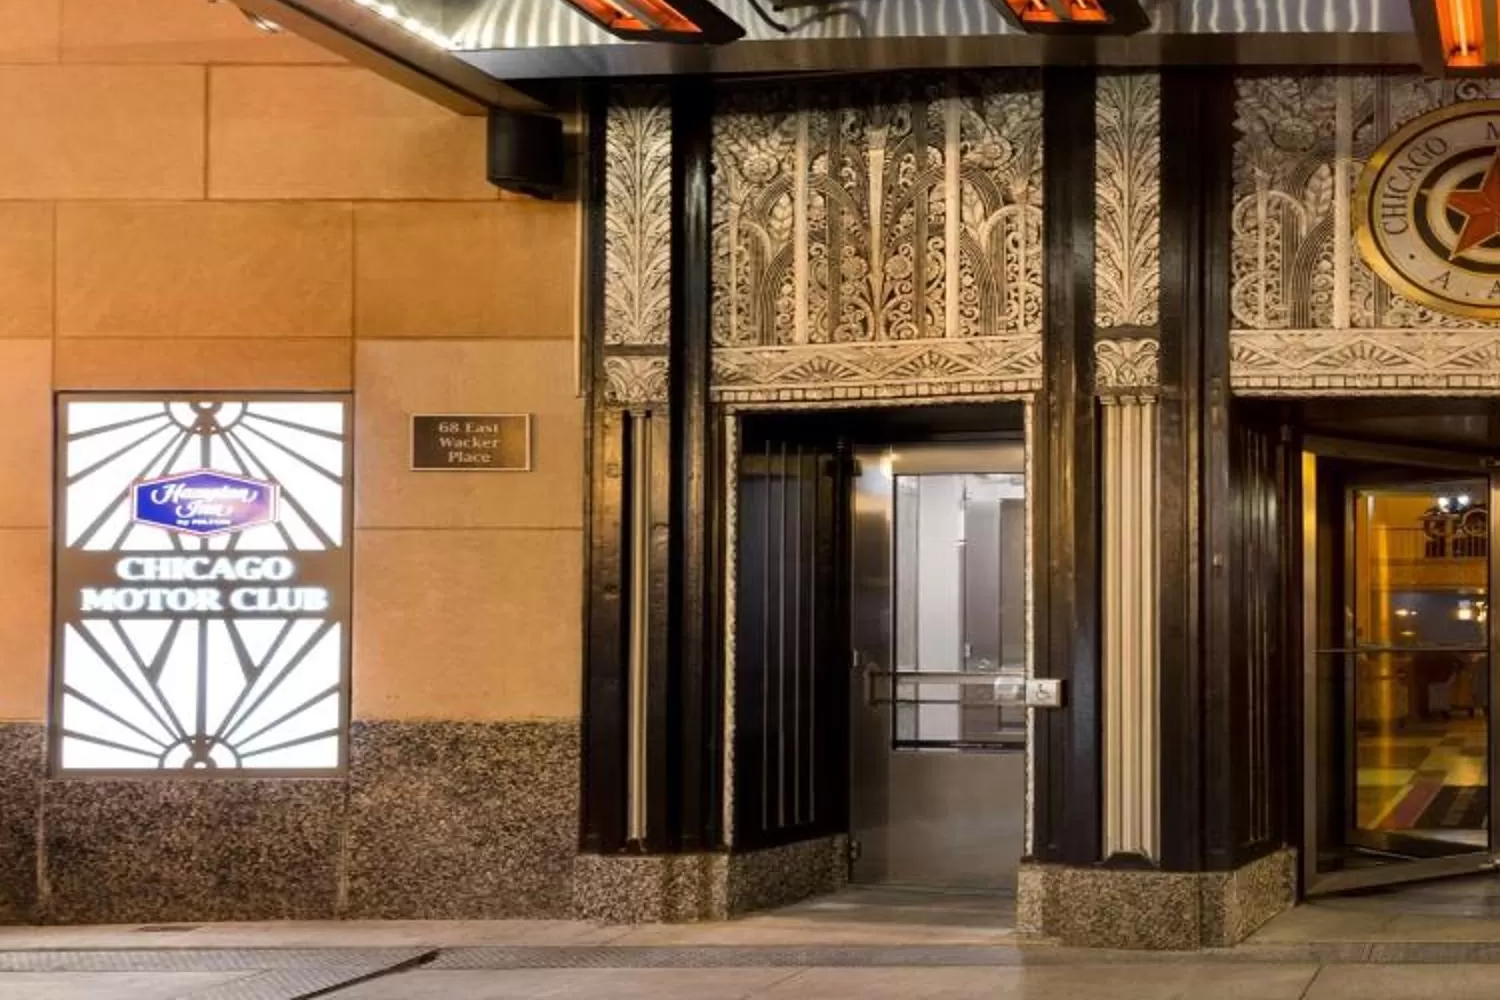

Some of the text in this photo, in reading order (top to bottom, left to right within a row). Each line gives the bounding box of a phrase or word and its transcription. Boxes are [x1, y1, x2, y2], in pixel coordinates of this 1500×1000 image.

[1381, 135, 1447, 236] CHICAGO
[438, 422, 499, 433] 68 East
[439, 436, 499, 449] Wacker
[447, 451, 492, 463] Place
[115, 556, 294, 581] CHICAGO
[79, 587, 329, 612] MOTOR CLUB
